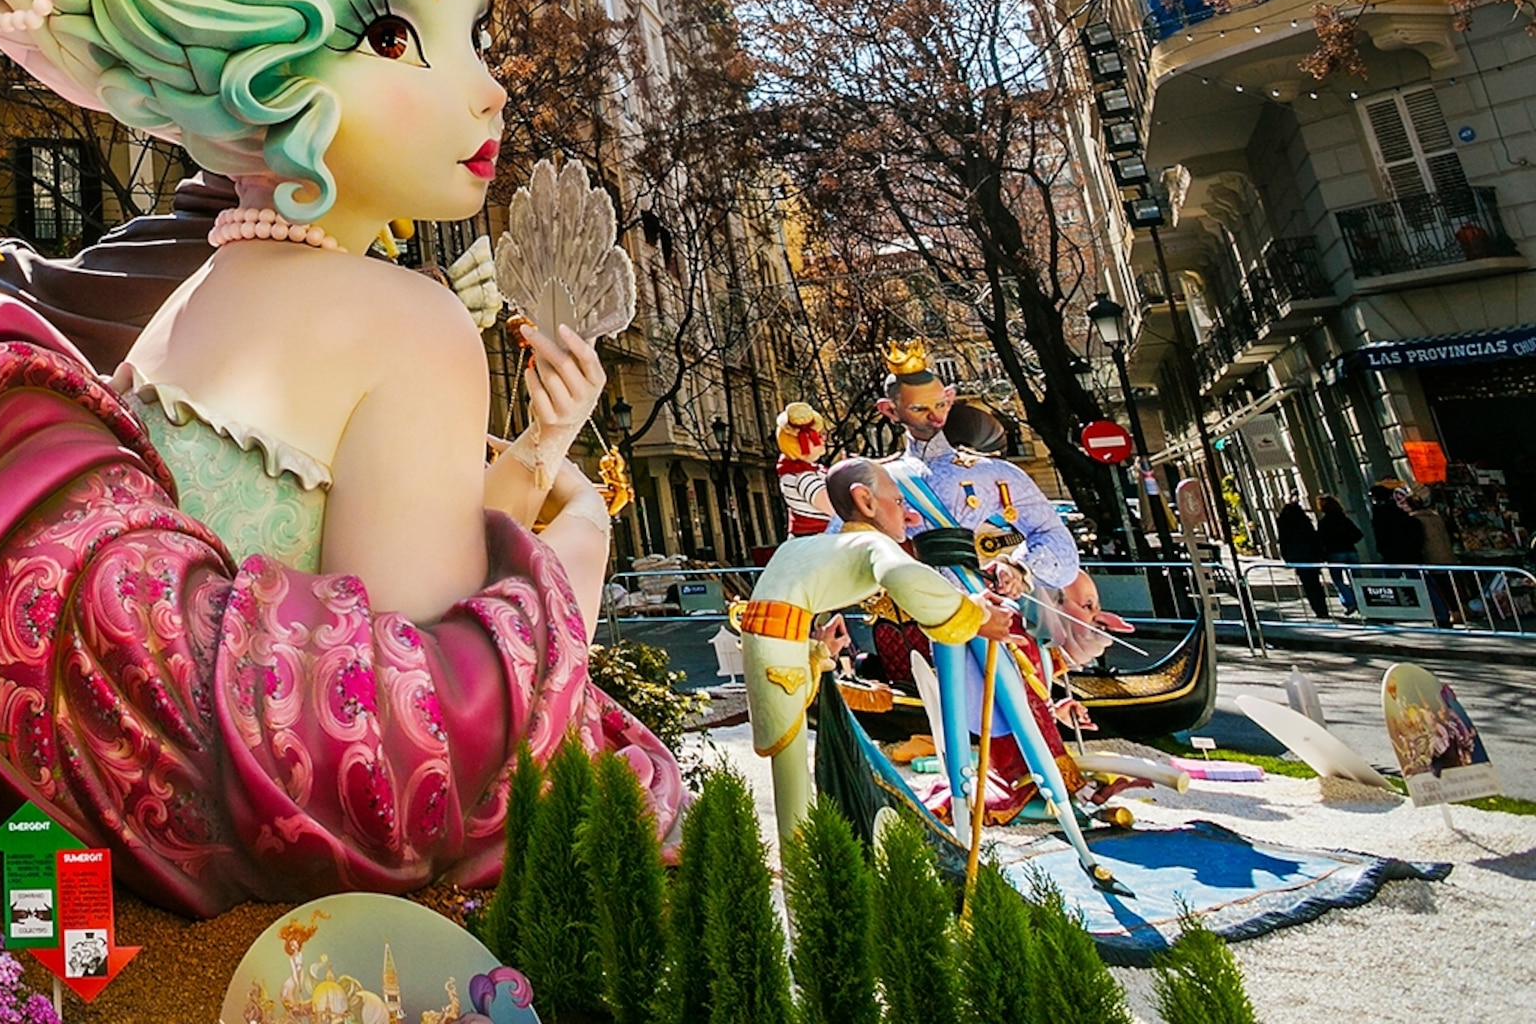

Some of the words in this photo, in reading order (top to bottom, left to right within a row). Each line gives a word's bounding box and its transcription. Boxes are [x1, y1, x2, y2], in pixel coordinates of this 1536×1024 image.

[1368, 351, 1402, 366] LAS
[1405, 339, 1508, 364] PROVINCIAS
[8, 821, 50, 831] EMERGENT
[63, 852, 103, 863] SUMERGIT
